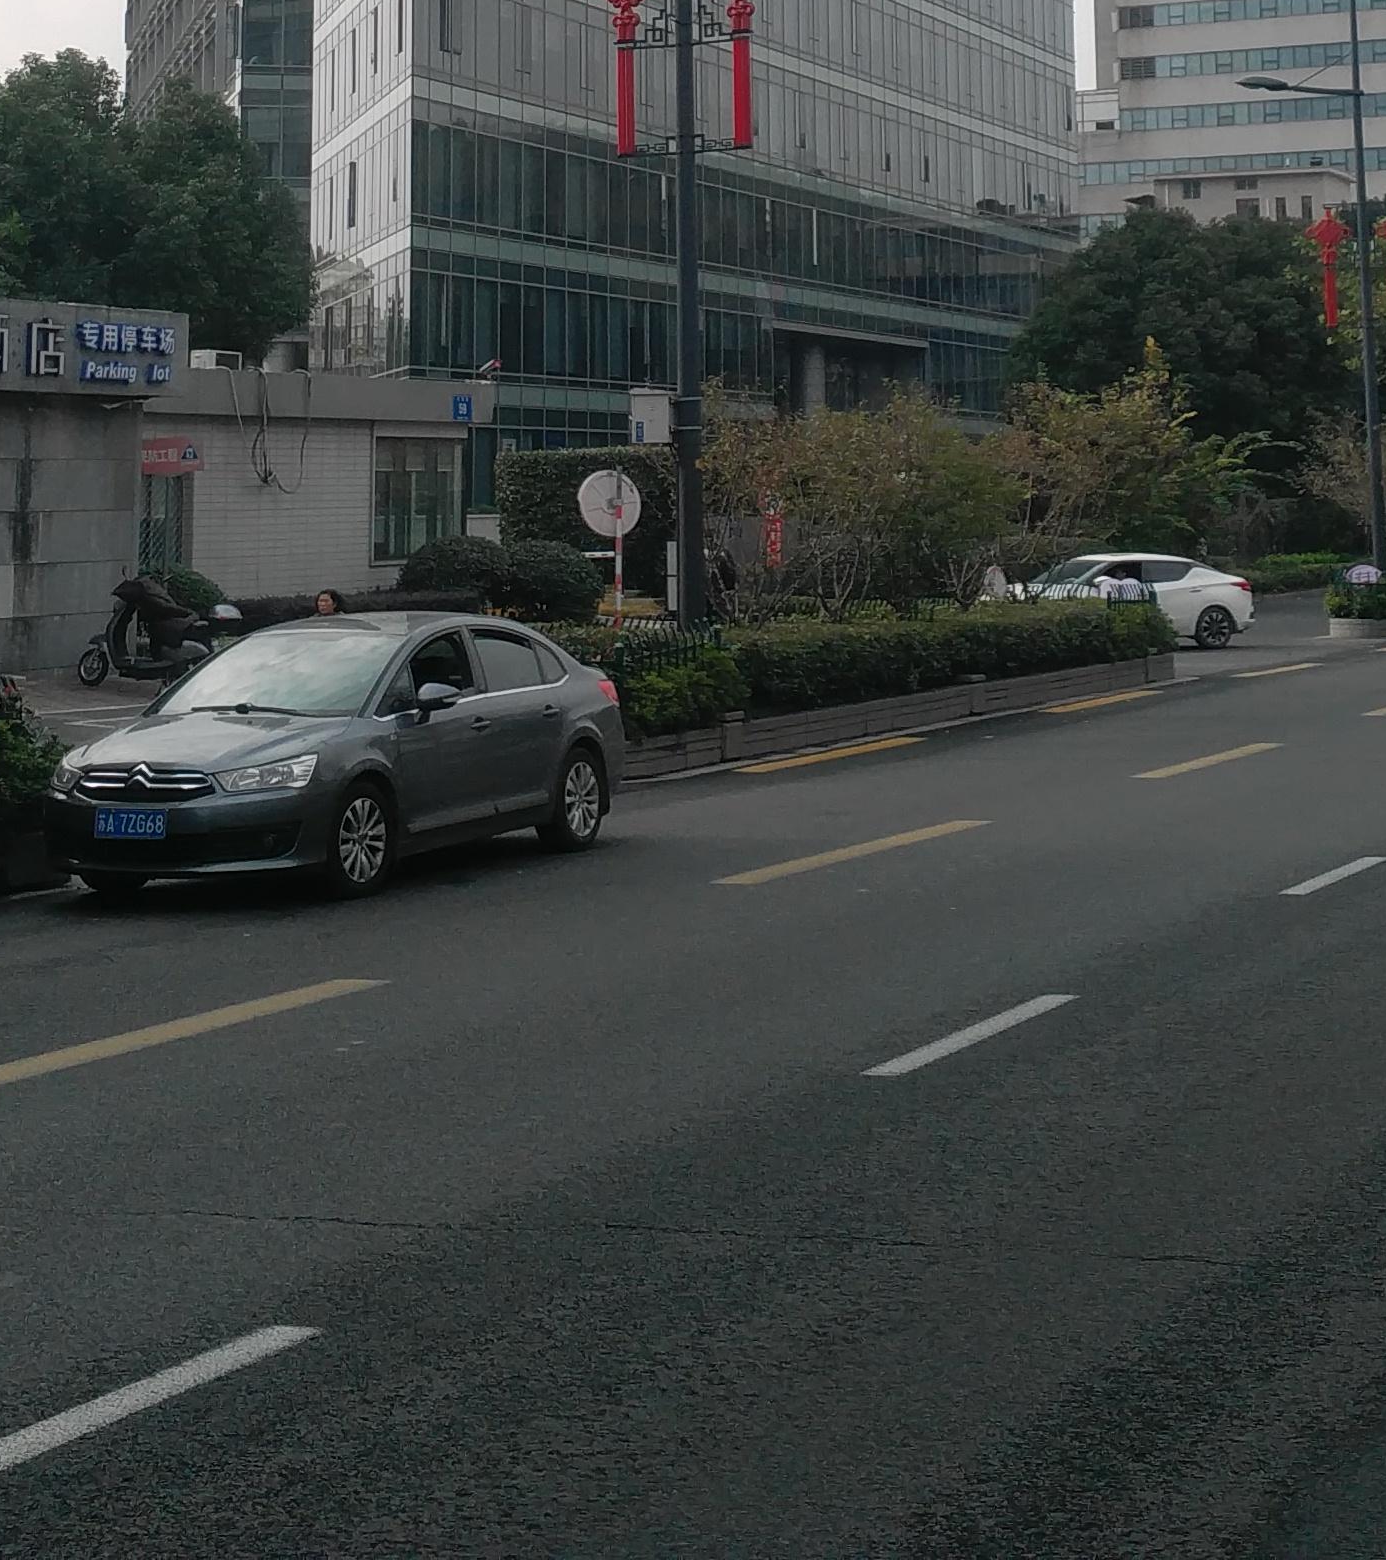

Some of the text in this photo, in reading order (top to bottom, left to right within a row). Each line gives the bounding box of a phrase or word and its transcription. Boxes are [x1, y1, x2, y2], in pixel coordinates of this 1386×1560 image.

[80, 321, 176, 356] 专用停车场
[85, 360, 171, 384] Parking lot
